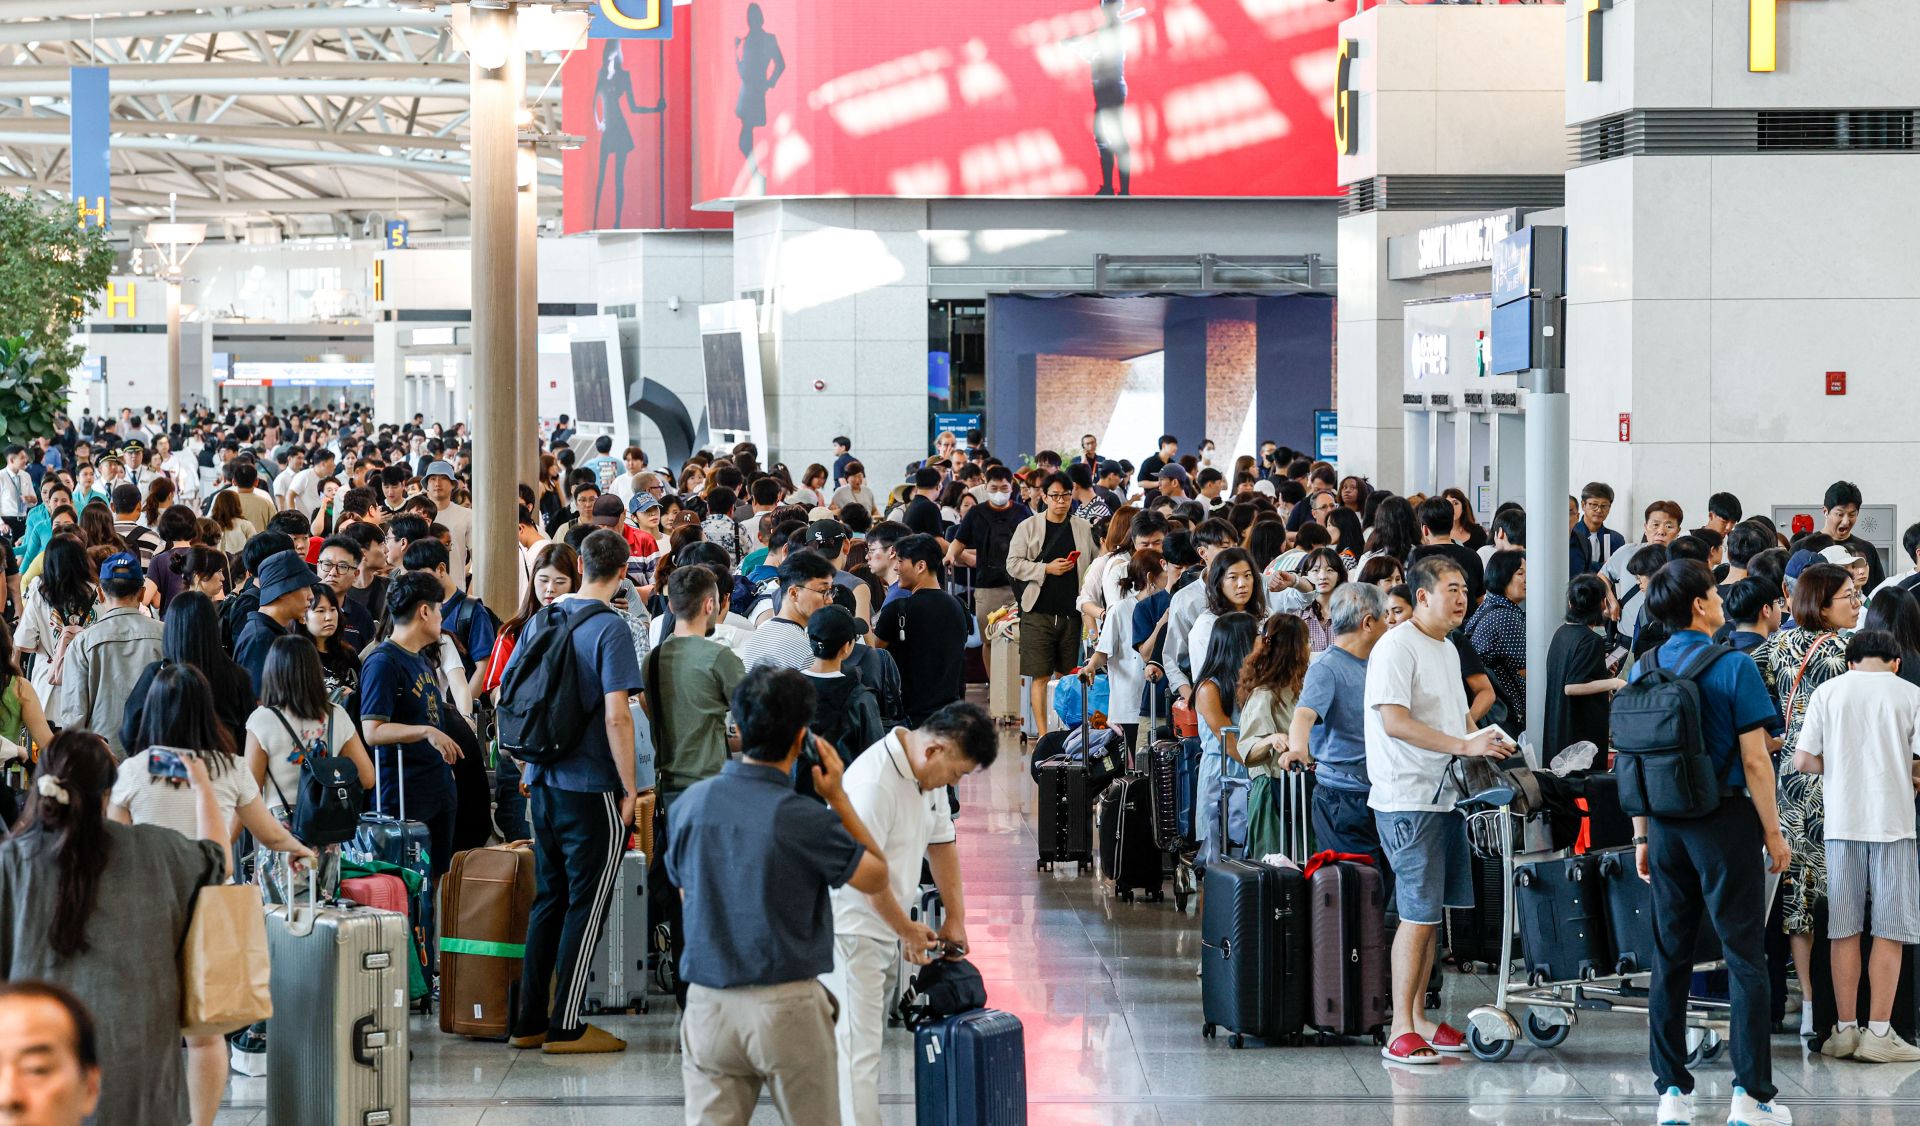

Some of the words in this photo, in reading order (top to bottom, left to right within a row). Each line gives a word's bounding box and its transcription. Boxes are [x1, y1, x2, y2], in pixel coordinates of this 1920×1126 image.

[1334, 39, 1355, 156] G
[392, 228, 404, 247] 5
[1418, 225, 1446, 270] SMART
[106, 281, 136, 319] H
